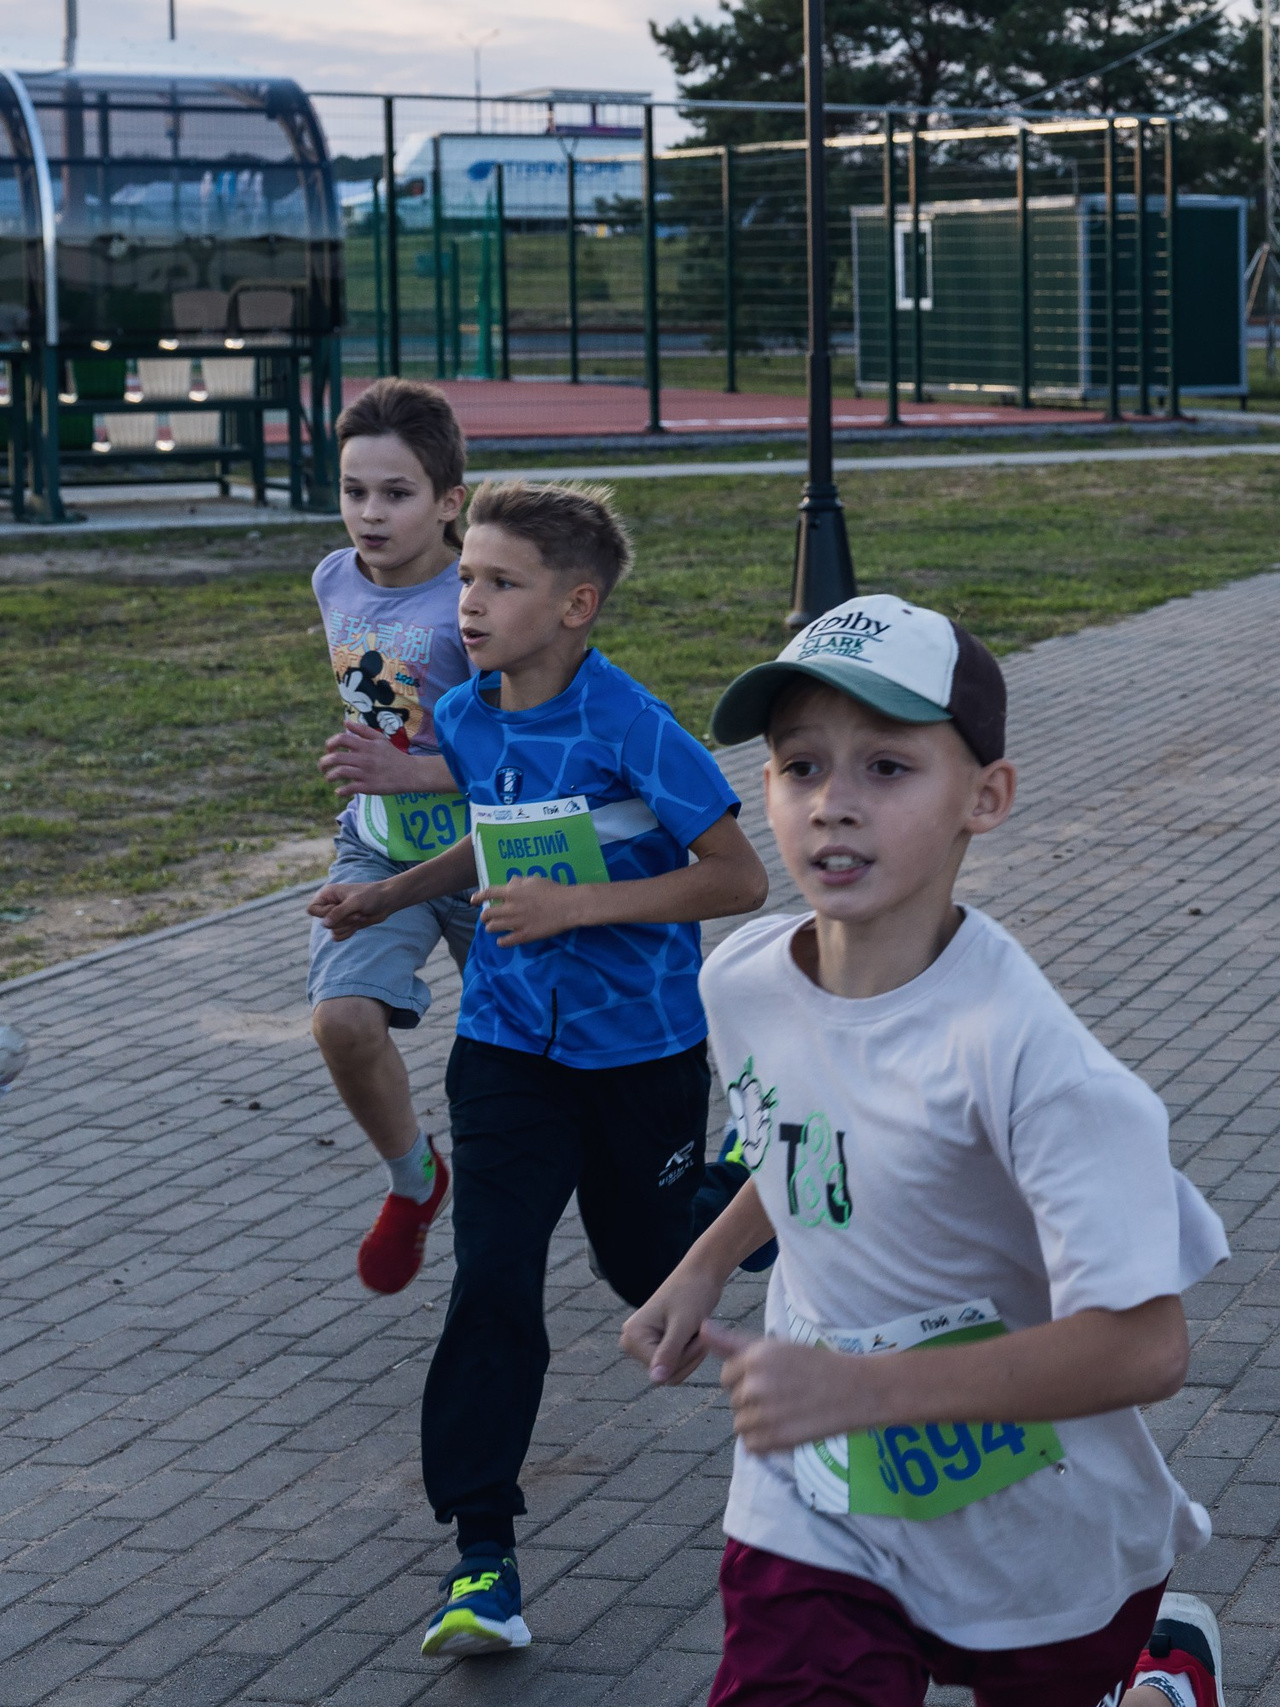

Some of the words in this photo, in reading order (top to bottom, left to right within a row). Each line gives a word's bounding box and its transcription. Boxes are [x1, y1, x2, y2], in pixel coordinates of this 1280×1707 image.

[803, 636, 866, 650] CLARK
[399, 798, 472, 851] 4297
[497, 829, 569, 860] САВЕЛИЙ
